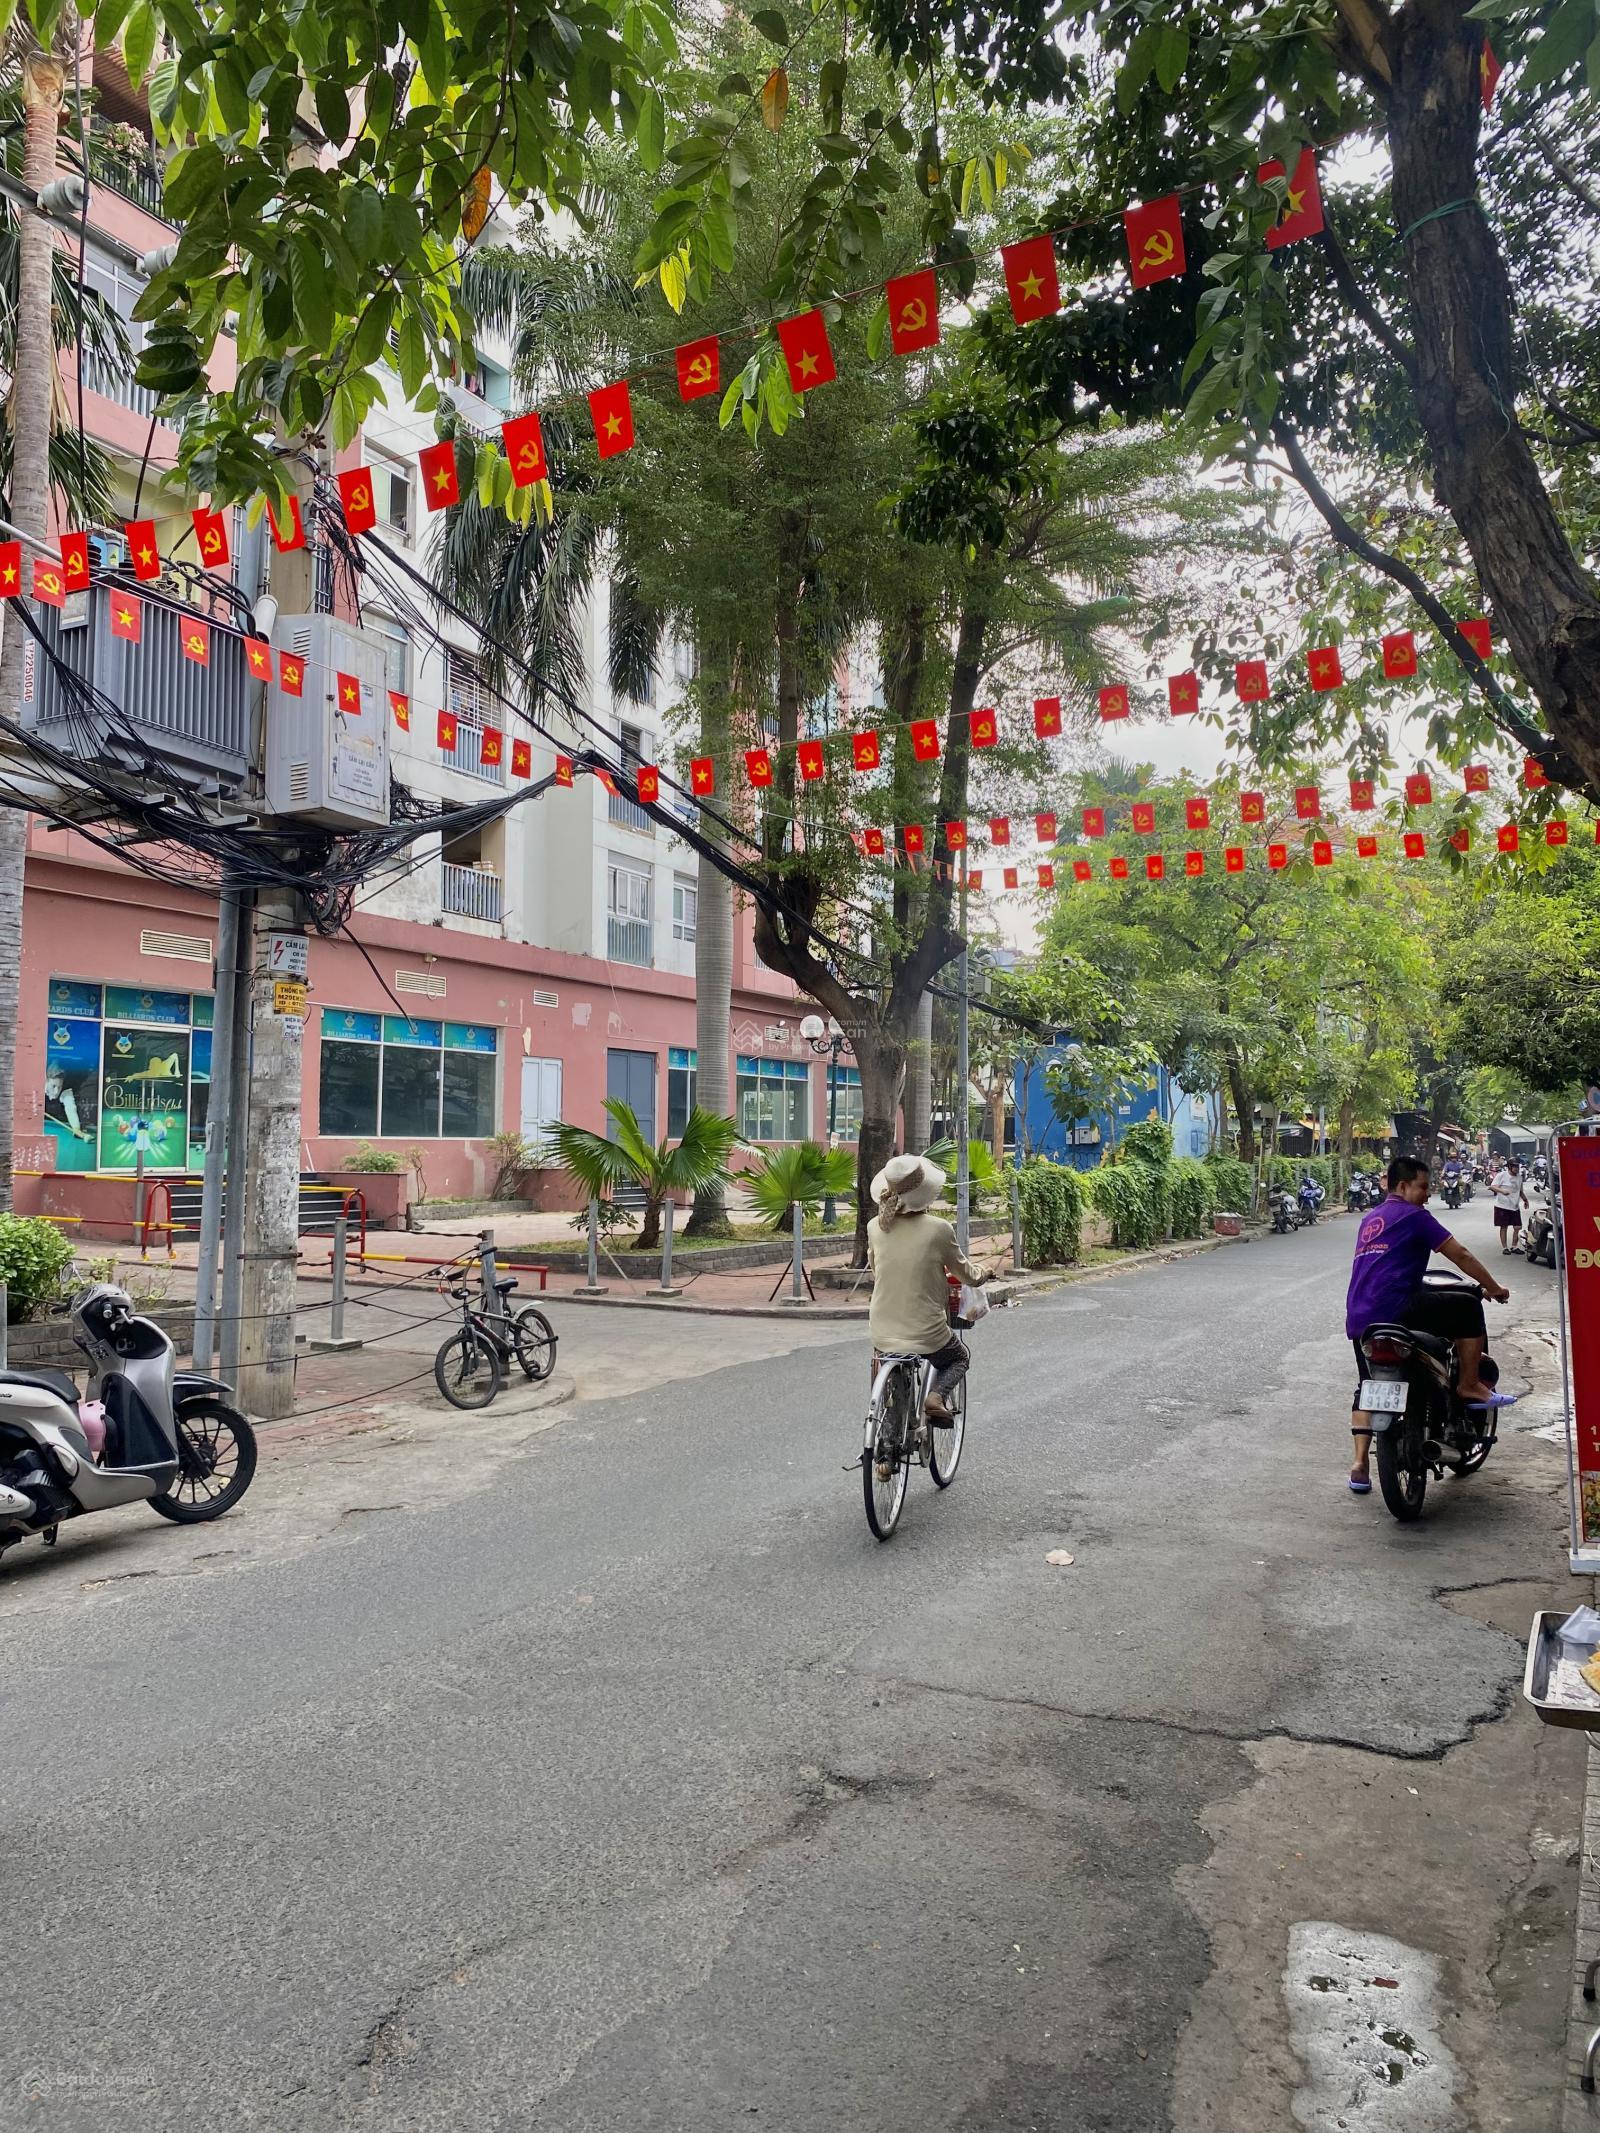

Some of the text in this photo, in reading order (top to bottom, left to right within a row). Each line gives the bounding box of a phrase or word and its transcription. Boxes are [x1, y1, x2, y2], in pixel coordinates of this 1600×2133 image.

[74, 1007, 95, 1016] CLUB
[117, 1011, 176, 1023] BILLIARDS CLUB
